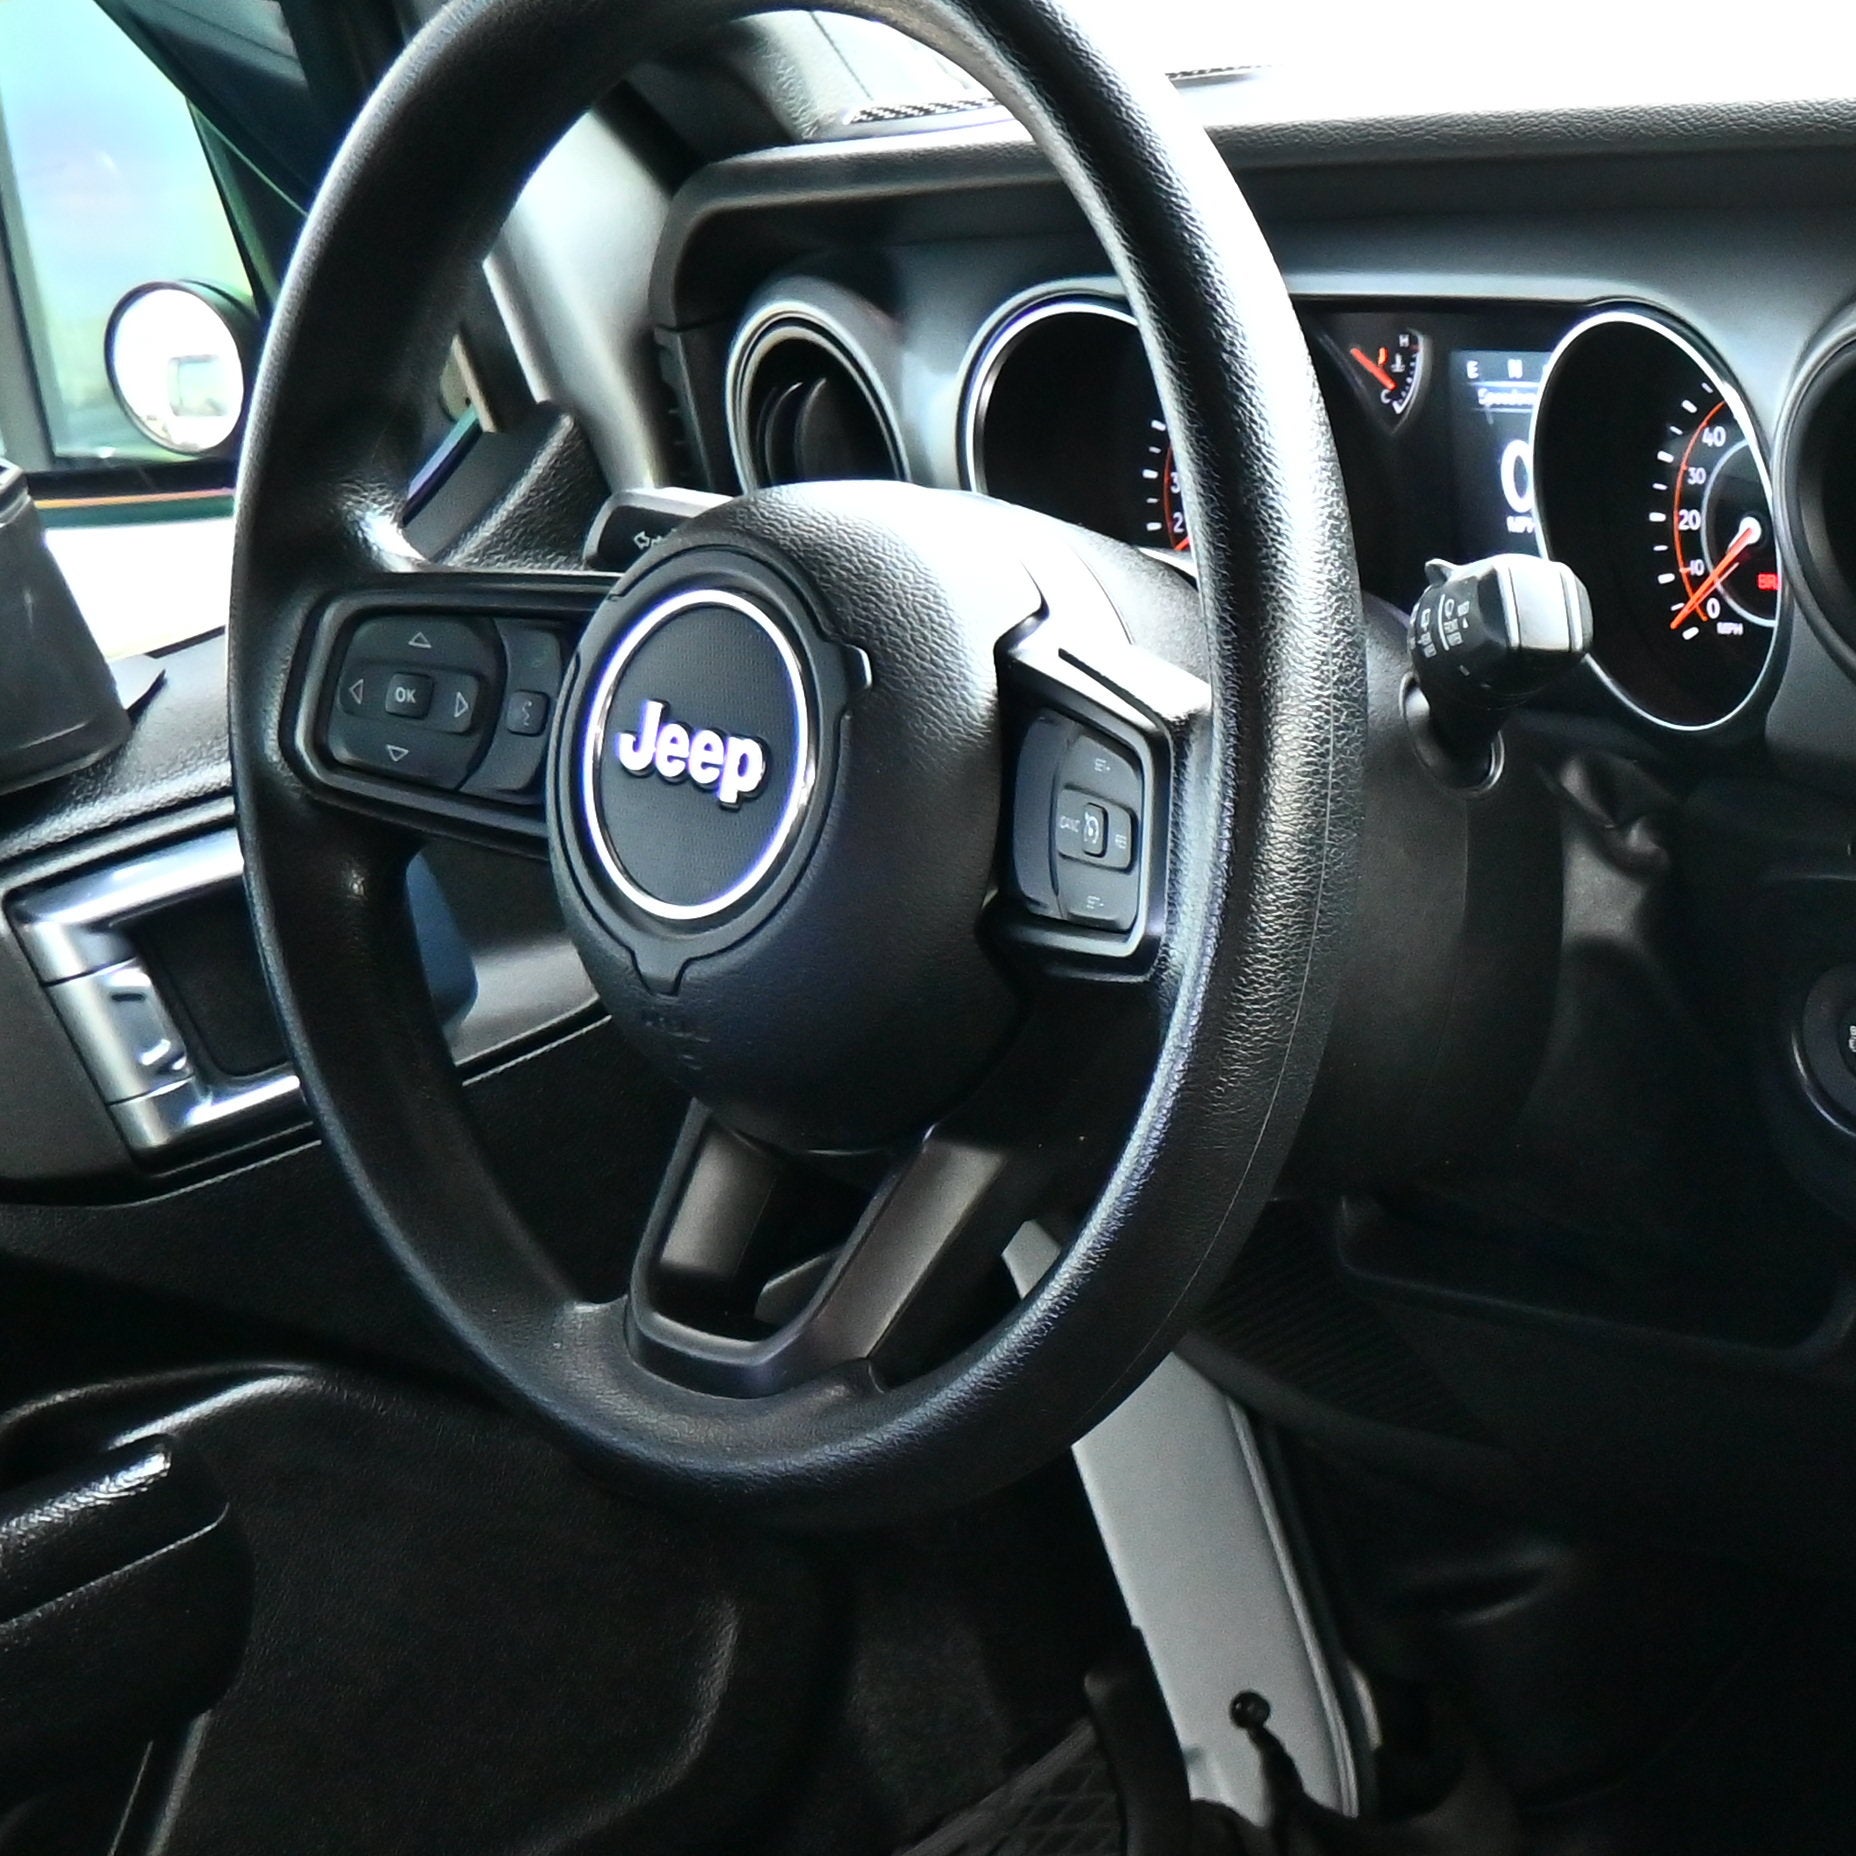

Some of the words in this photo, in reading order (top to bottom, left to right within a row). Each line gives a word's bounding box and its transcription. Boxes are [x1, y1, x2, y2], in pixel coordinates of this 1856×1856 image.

[1702, 426, 1726, 447] 40
[1170, 471, 1181, 494] 3
[1501, 439, 1534, 514] 0
[1687, 466, 1707, 485] 30
[1172, 511, 1185, 534] 2
[1678, 509, 1701, 531] 20
[1689, 559, 1704, 576] 10
[1706, 597, 1721, 619] 0
[394, 686, 417, 704] OK
[614, 699, 768, 807] Jeep
